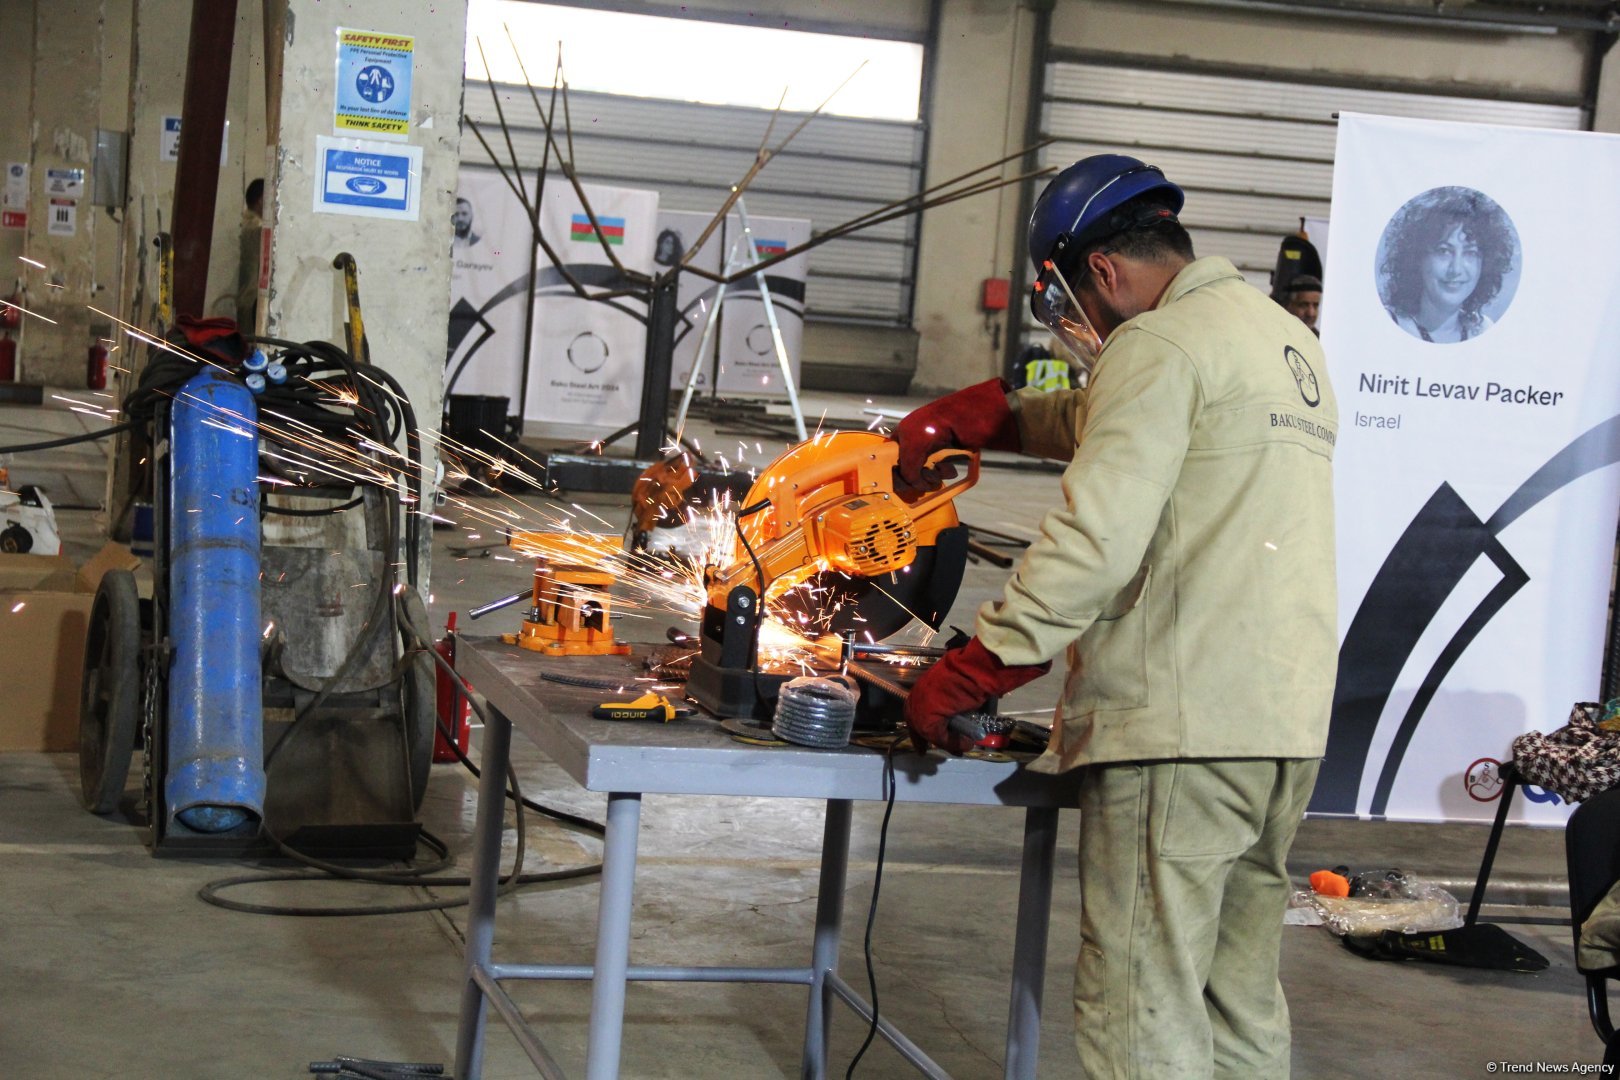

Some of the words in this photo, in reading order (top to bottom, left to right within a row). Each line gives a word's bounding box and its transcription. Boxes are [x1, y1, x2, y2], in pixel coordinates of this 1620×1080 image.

[344, 34, 381, 44] SAFETY
[382, 38, 410, 47] FIRST
[345, 119, 369, 128] THINK
[371, 122, 403, 131] SAFETY
[354, 157, 382, 167] NOTICE
[1359, 372, 1410, 396] Nirit
[1416, 377, 1480, 400] Levav
[1485, 382, 1564, 406] Packer
[1270, 413, 1297, 428] BAKU
[1297, 418, 1316, 436] STEEL
[1355, 411, 1401, 429] Israel
